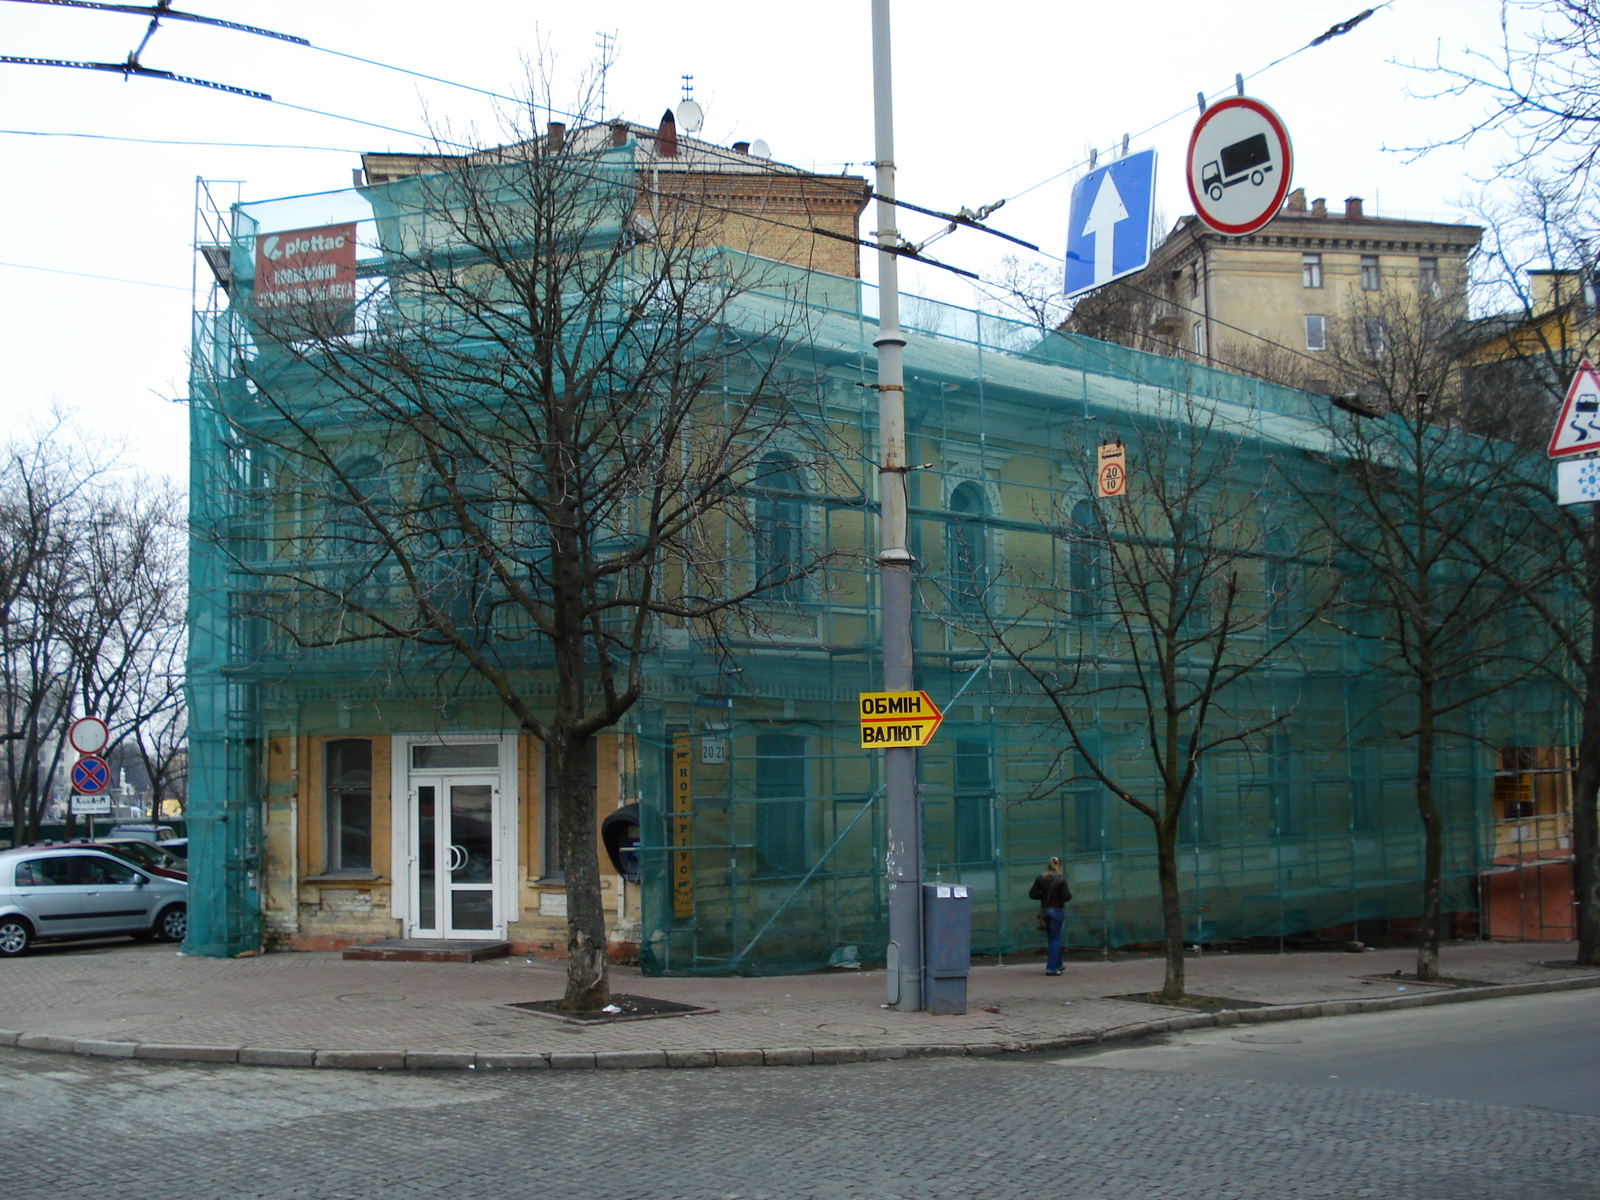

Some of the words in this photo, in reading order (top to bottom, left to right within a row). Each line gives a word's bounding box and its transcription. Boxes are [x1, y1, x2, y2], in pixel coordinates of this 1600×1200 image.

[285, 234, 345, 259] plettac
[1107, 467, 1117, 478] 20
[1107, 480, 1115, 489] 10
[862, 697, 921, 714] ОБМІН
[863, 725, 923, 743] ВАЛЮТ
[703, 746, 714, 758] 20
[716, 746, 725, 758] 21
